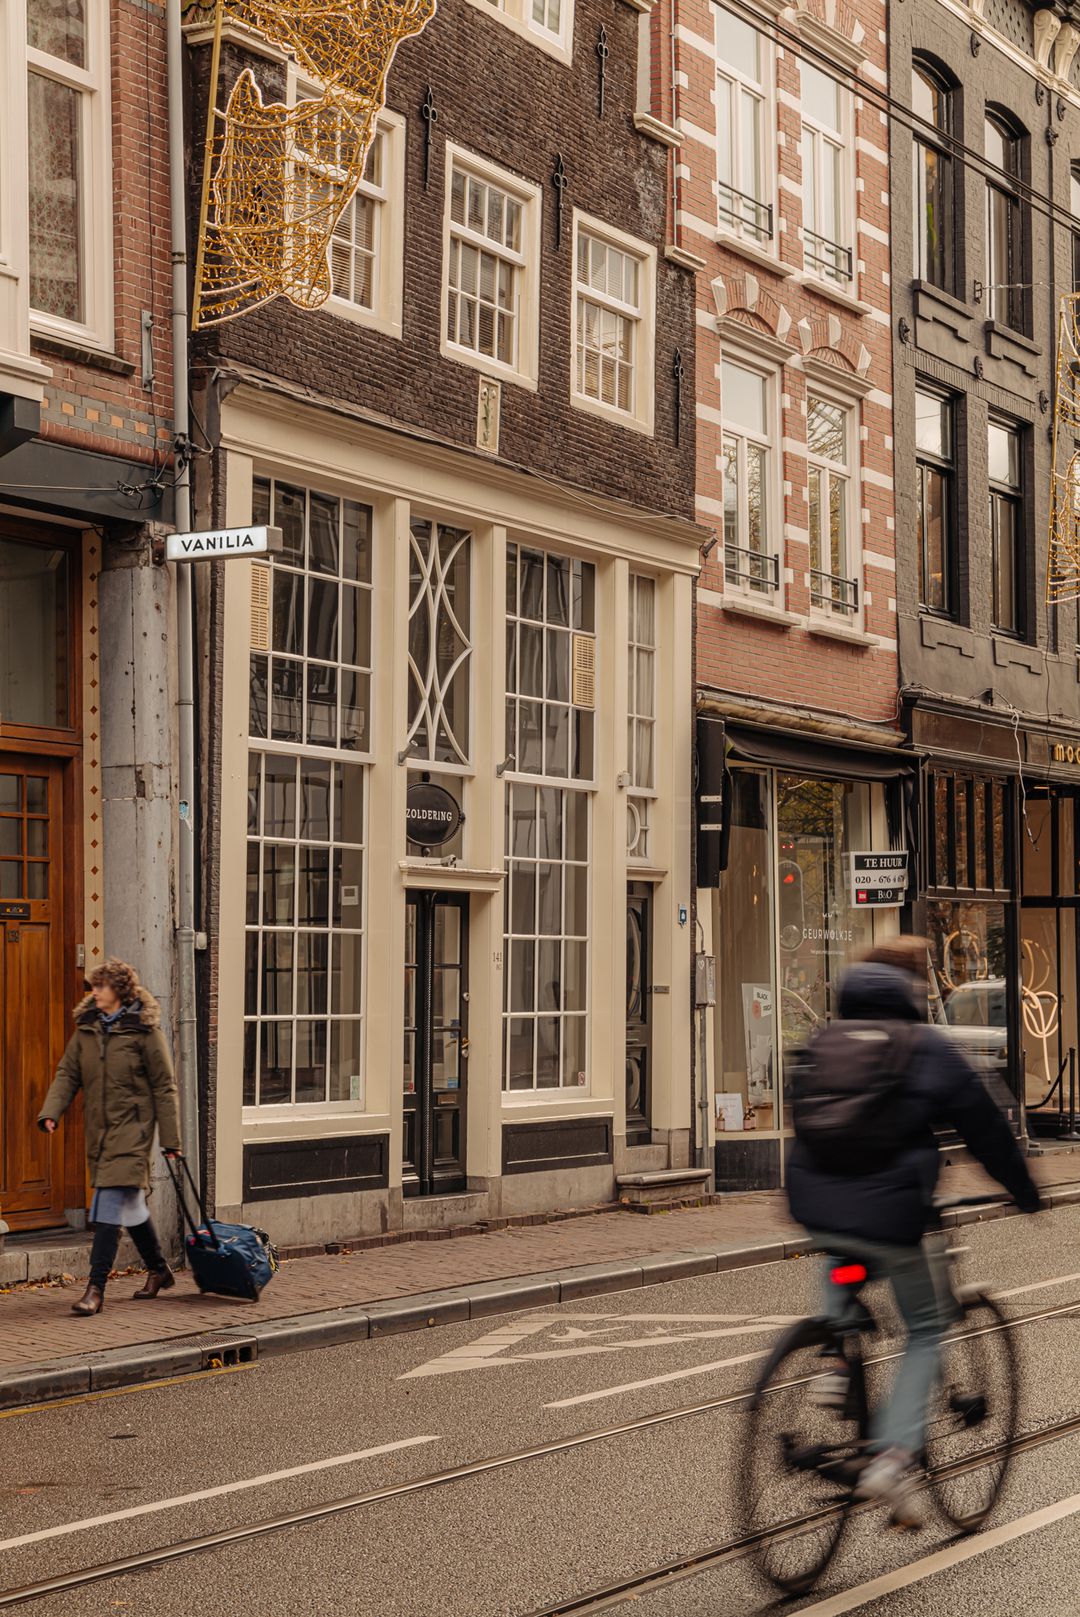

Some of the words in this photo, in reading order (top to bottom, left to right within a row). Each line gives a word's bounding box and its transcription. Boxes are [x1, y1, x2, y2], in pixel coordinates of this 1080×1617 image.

[181, 534, 254, 552] VANILIA
[406, 808, 453, 822] ZOLDERING
[864, 858, 878, 868] TE
[880, 857, 903, 868] HUUR
[855, 876, 871, 884] 020
[878, 874, 891, 884] 676
[802, 928, 853, 942] GEURWOLKJE
[493, 951, 503, 962] 141
